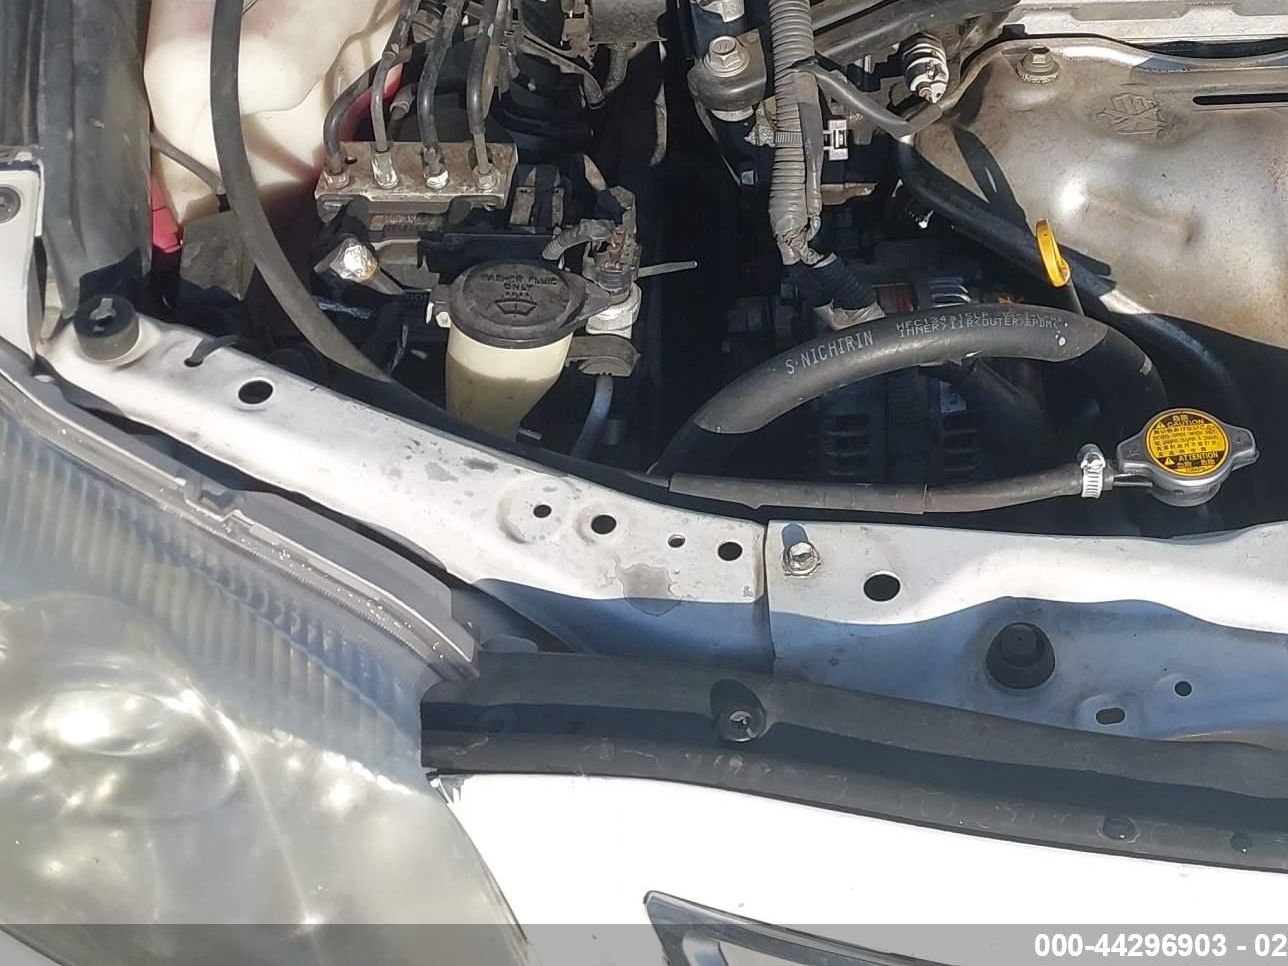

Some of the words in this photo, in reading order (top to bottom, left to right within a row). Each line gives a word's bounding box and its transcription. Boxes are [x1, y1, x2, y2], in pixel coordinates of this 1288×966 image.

[503, 282, 534, 291] ONLY
[1166, 419, 1205, 428] CAUTION
[1178, 452, 1219, 462] ATTENTION
